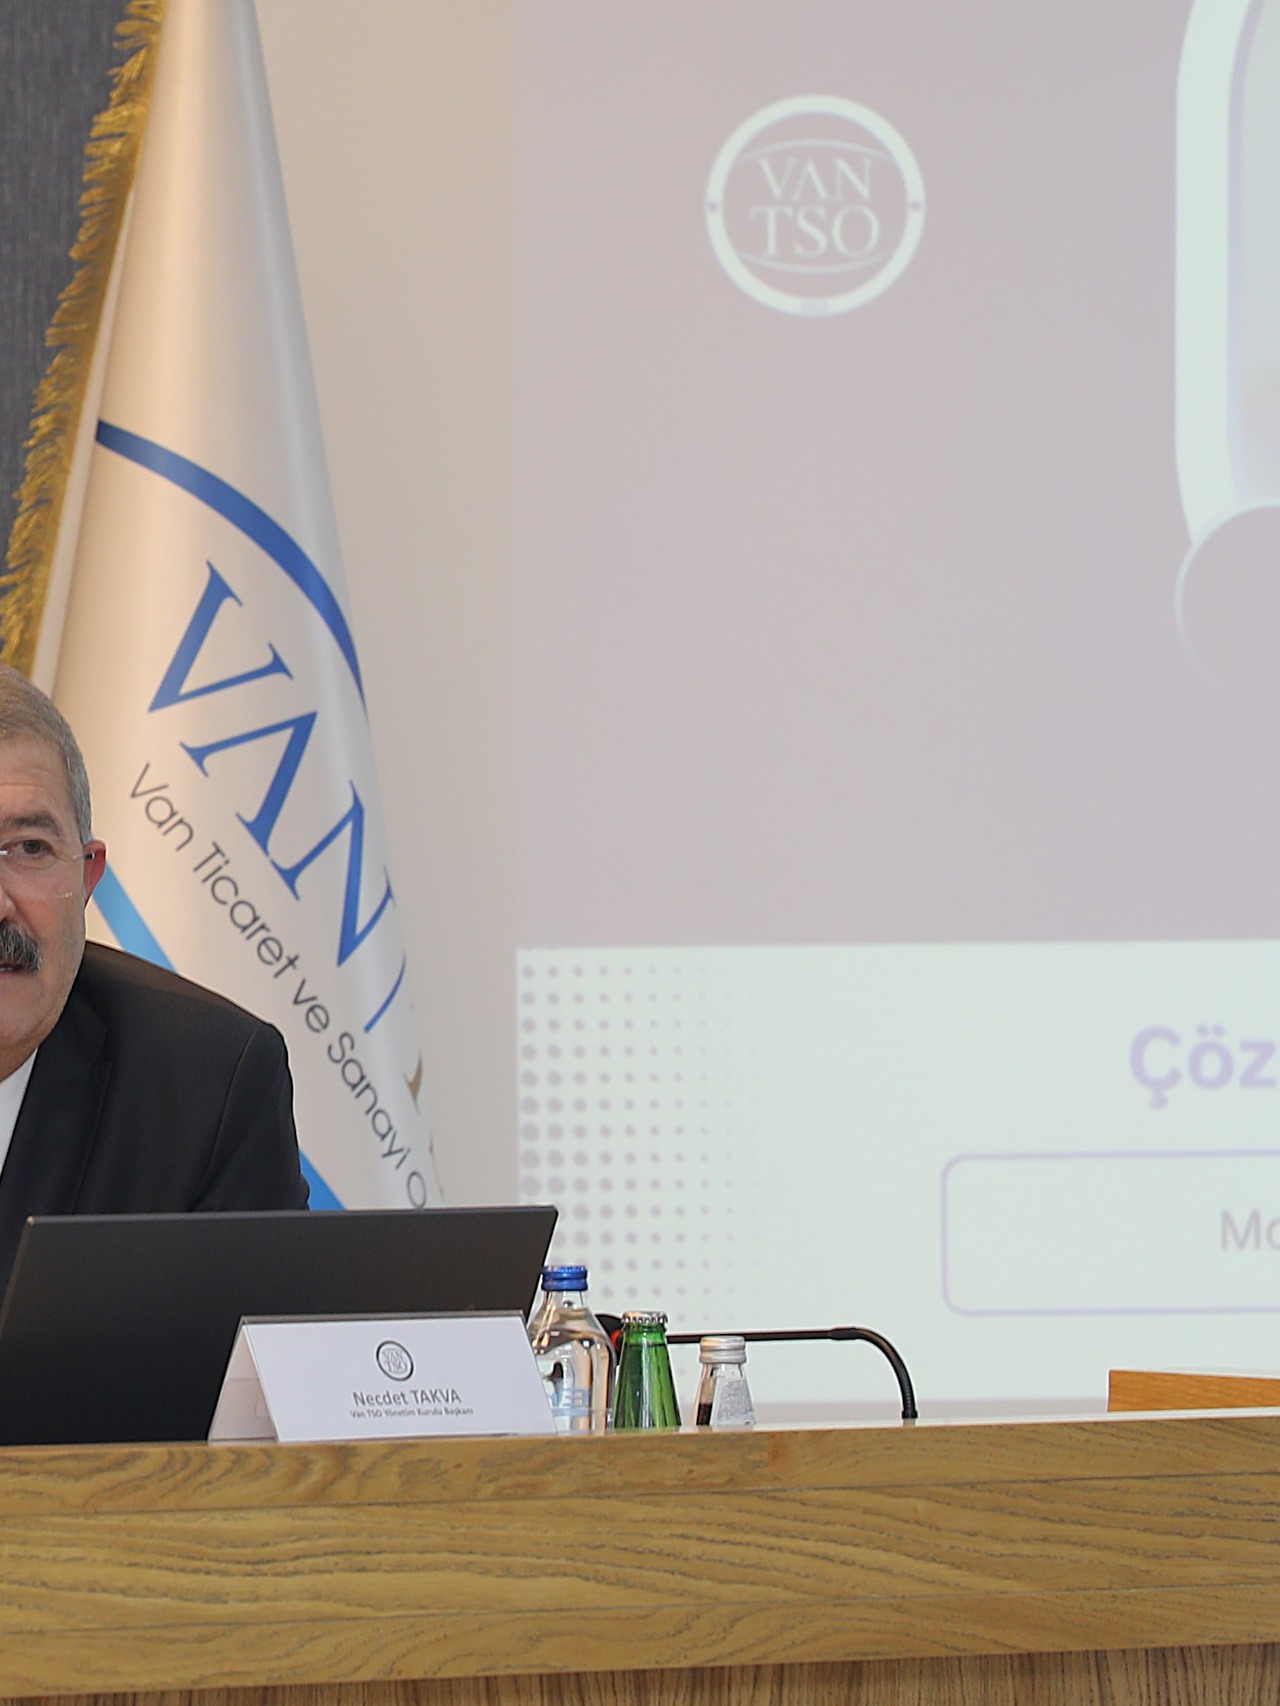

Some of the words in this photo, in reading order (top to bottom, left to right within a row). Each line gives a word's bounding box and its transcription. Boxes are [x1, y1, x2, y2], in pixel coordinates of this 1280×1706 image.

[757, 156, 875, 201] VAN
[749, 203, 881, 259] TSO
[148, 559, 397, 968] VAN
[130, 762, 194, 852] Van
[192, 841, 299, 980] Ticaret
[292, 977, 331, 1034] ve
[326, 1031, 411, 1170] Sanayi
[352, 1390, 409, 1406] Necdet
[410, 1388, 462, 1404] TAKVA
